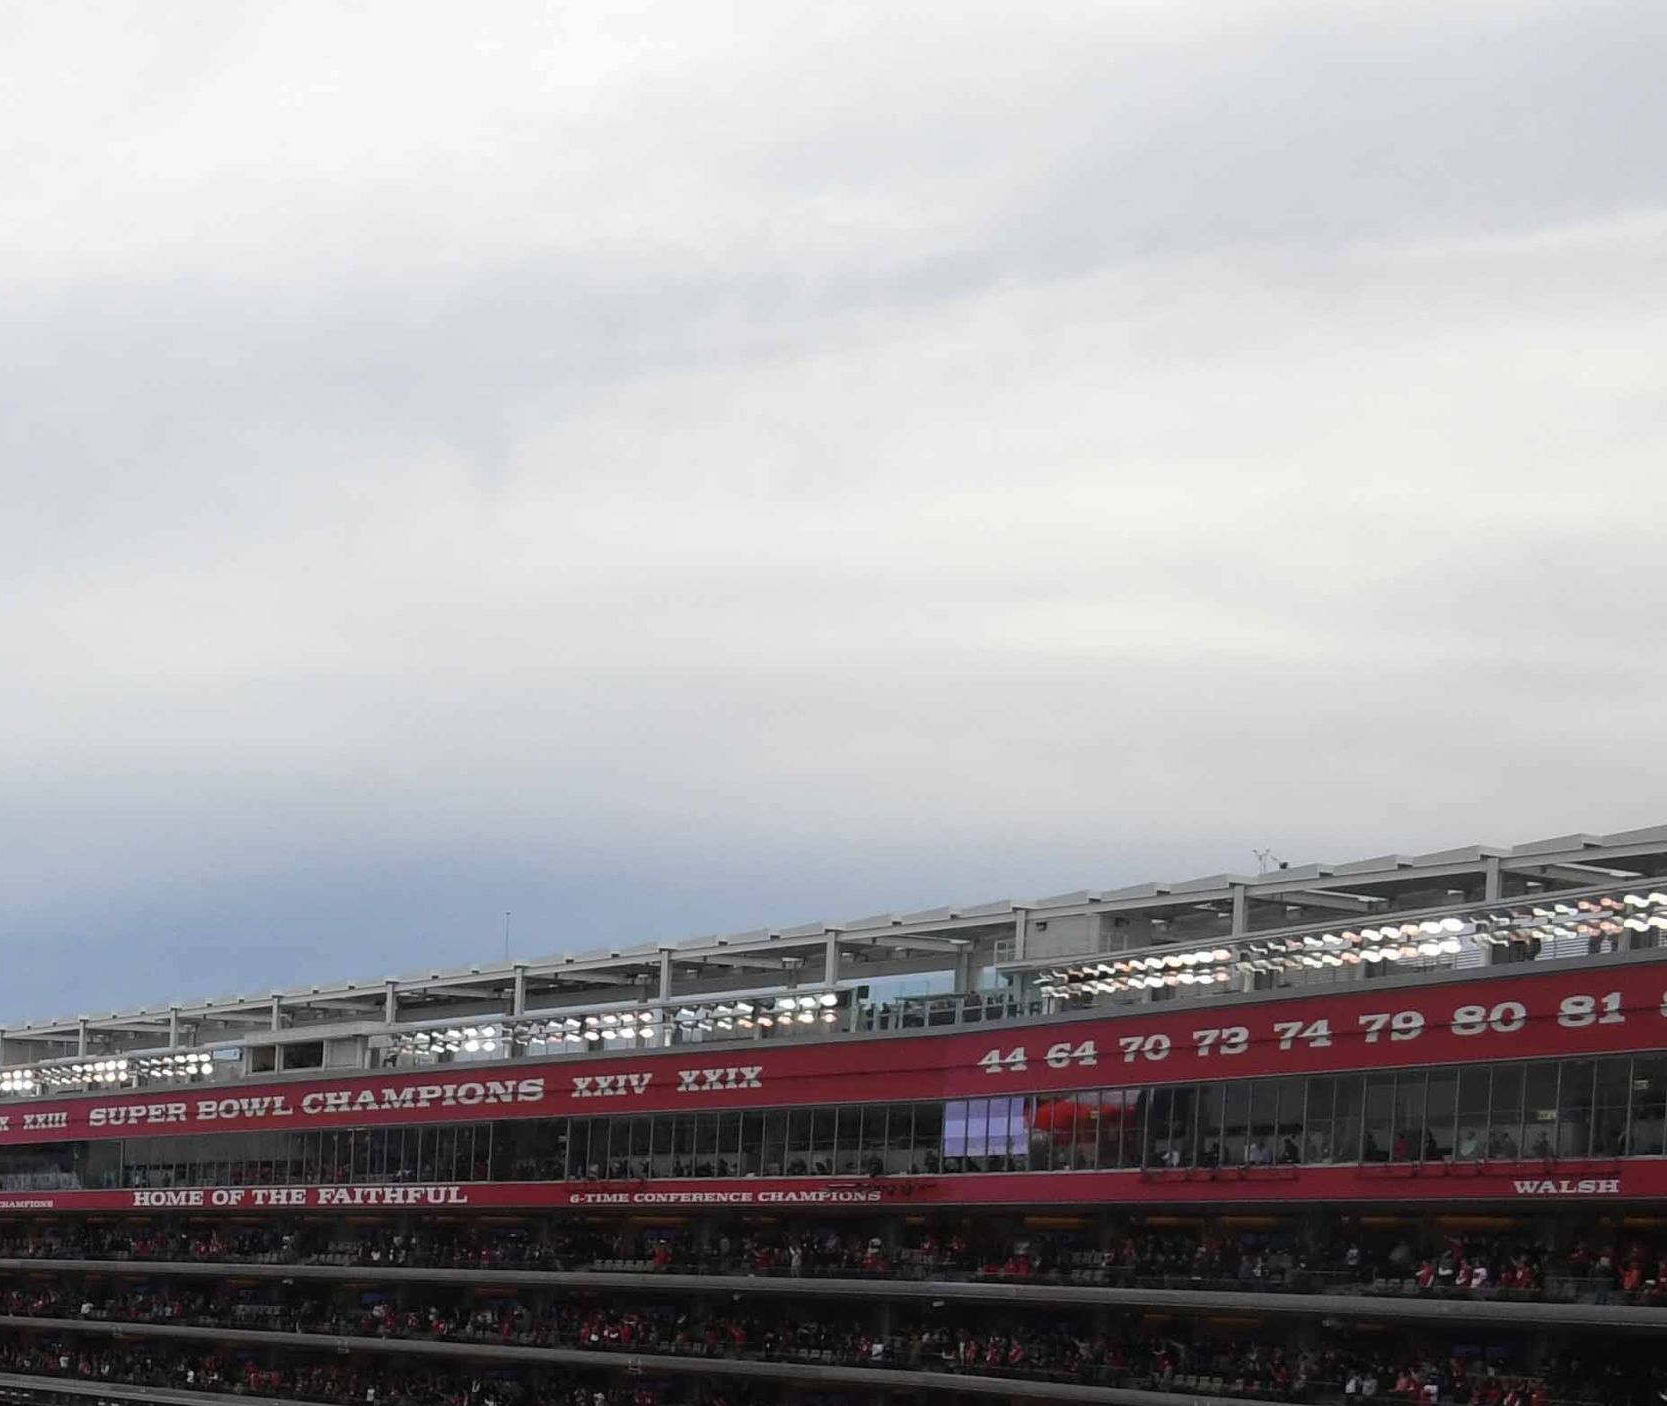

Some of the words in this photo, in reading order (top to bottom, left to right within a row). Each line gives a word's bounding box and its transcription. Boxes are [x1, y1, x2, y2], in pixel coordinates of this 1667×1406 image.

[977, 1045, 1028, 1074] 44
[1043, 1040, 1098, 1069] 64
[1118, 1033, 1171, 1063] 70
[1192, 1026, 1249, 1058] 73
[1273, 1019, 1333, 1050] 74
[1358, 1010, 1425, 1043] 79
[1450, 1001, 1527, 1036] 80
[1557, 991, 1625, 1027] 81
[22, 1112, 68, 1131] XXIII
[88, 1102, 187, 1128] SUPER
[194, 1095, 293, 1122] BOWL
[301, 1077, 545, 1115] CHAMPIONS
[569, 1072, 653, 1098] XXIV
[676, 1065, 763, 1092] XXIX
[133, 1191, 204, 1207] HOME
[212, 1190, 245, 1206] OF
[250, 1187, 307, 1206] THE
[317, 1186, 468, 1206] FAITHFUL
[569, 1192, 629, 1204] 6-TIME
[633, 1191, 753, 1203] CONFERENCE
[758, 1190, 882, 1202] CHAMPIONS
[1513, 1179, 1620, 1194] WALSH
